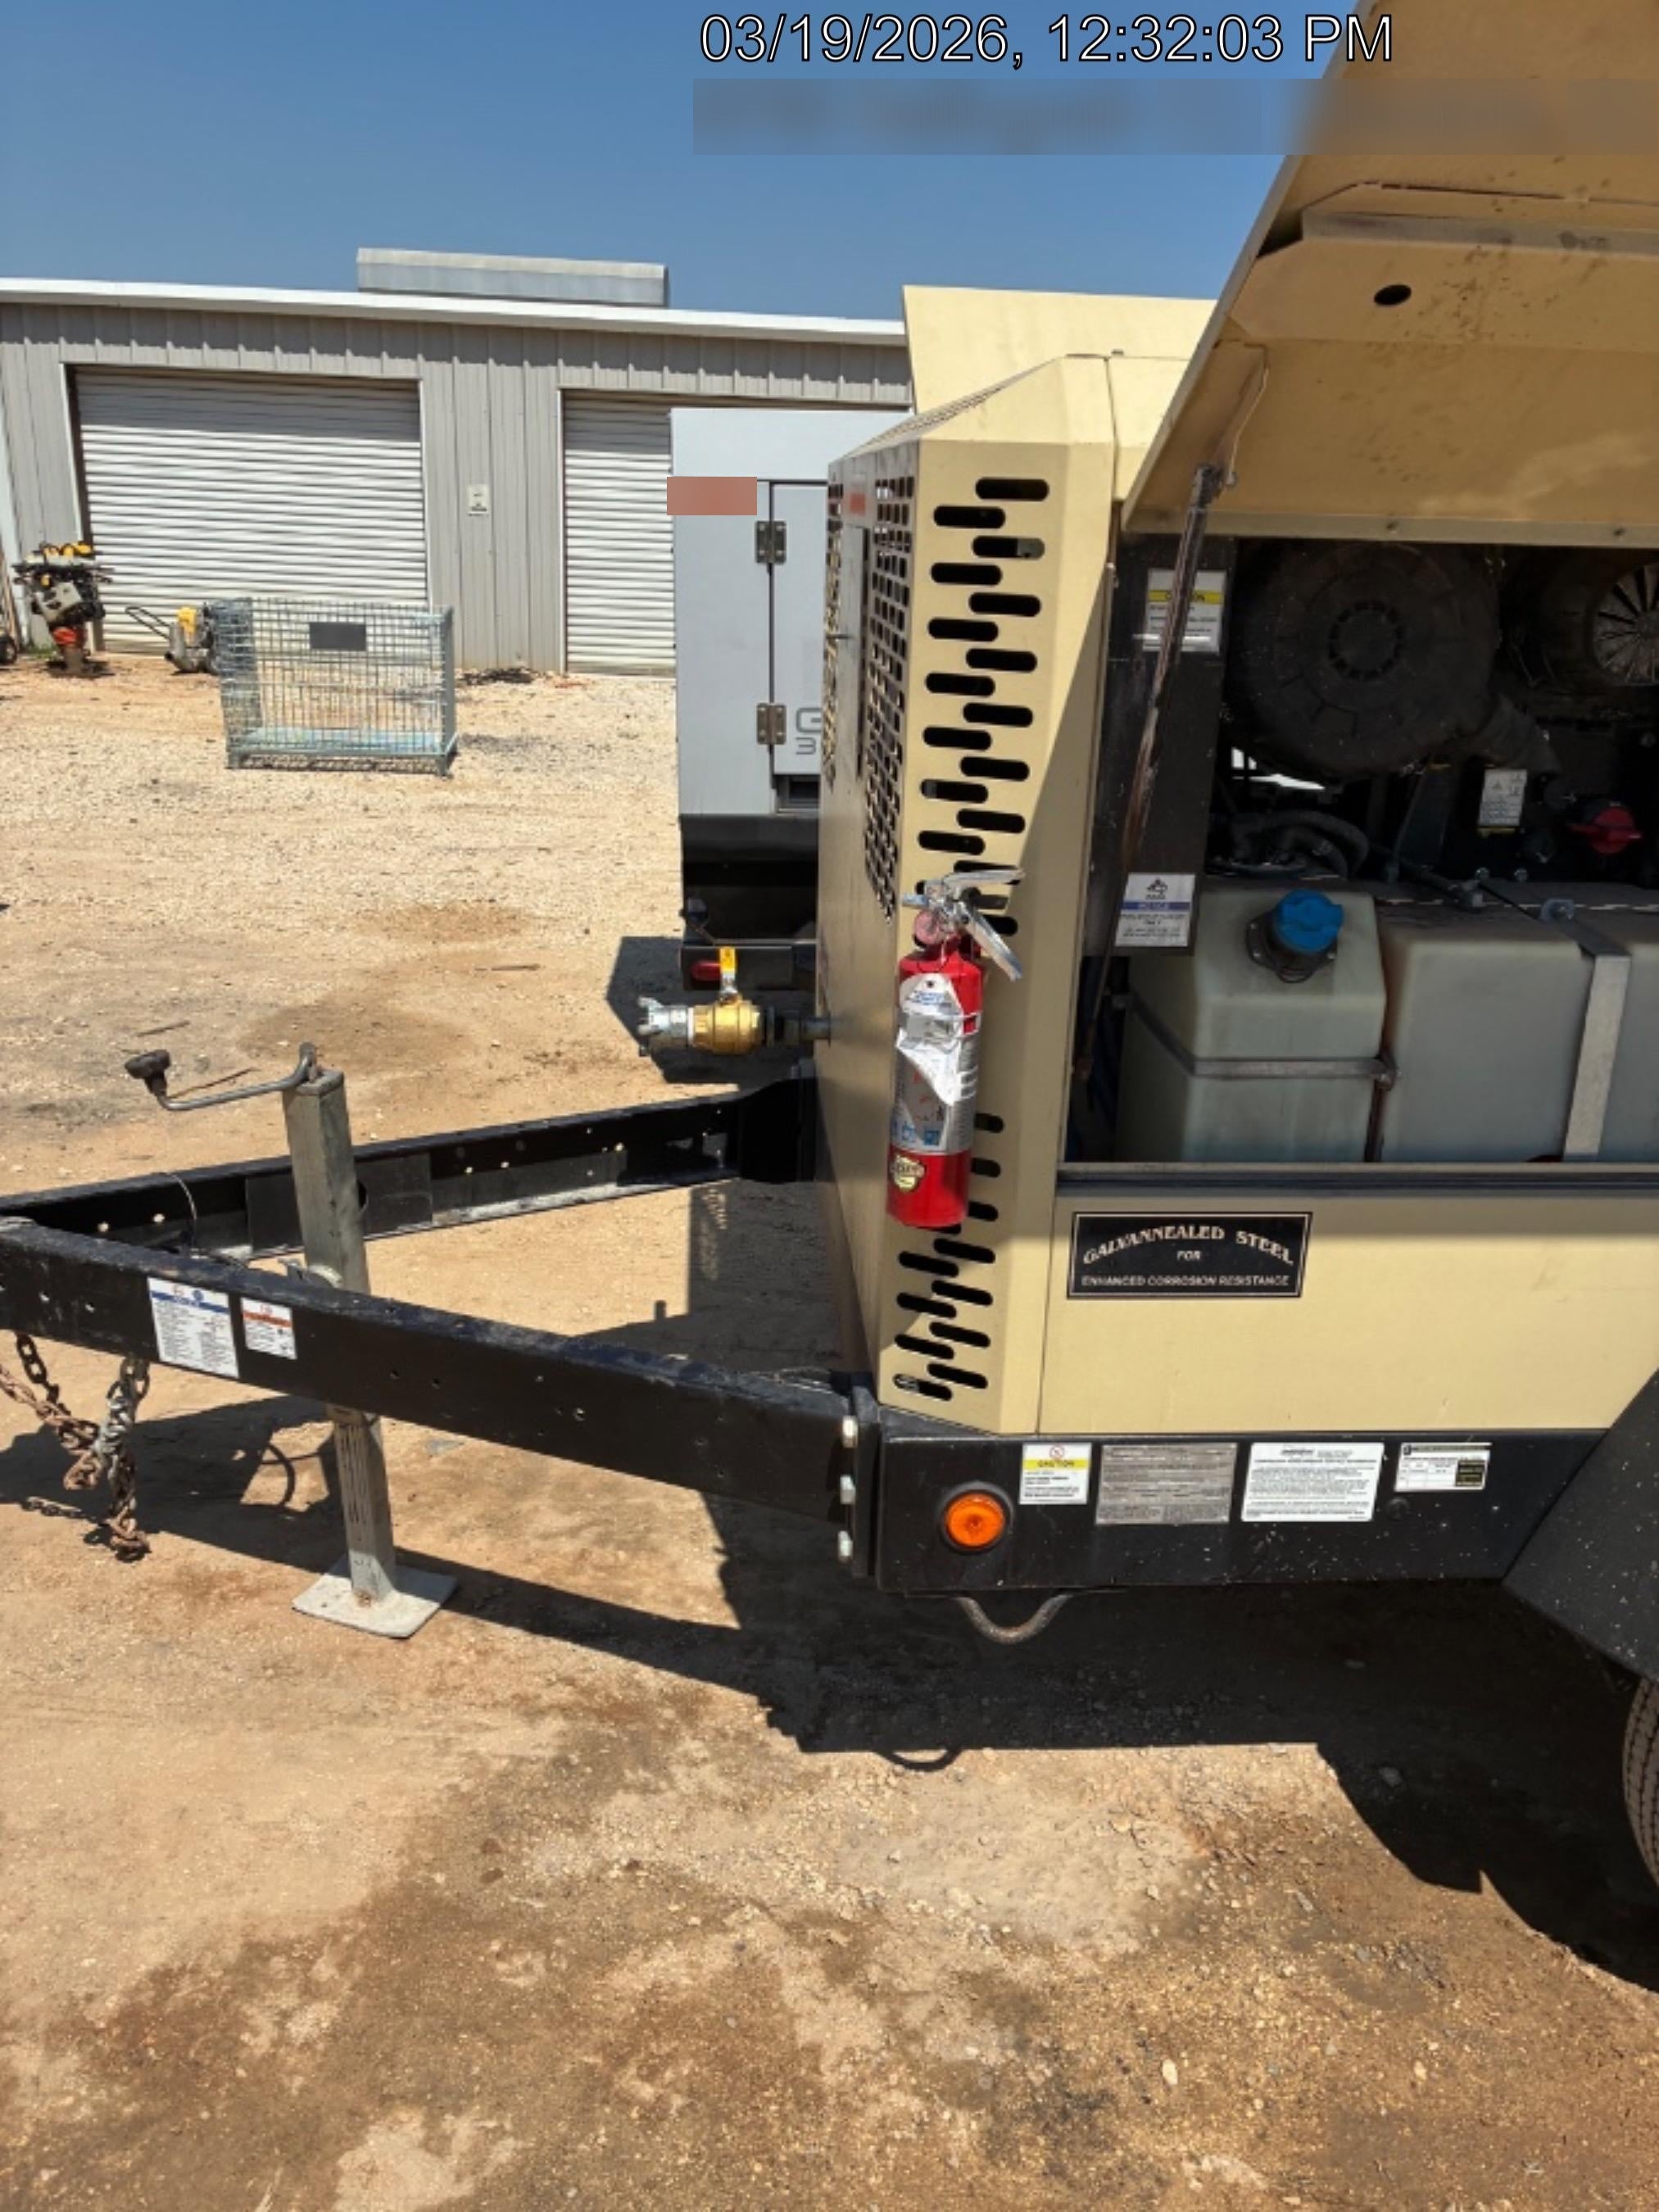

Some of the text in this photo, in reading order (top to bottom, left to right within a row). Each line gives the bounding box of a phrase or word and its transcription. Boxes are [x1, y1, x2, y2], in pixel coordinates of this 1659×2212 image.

[1082, 1224, 1294, 1265] GALVANNEALED STEEL
[1176, 1250, 1201, 1260] FOR
[1081, 1274, 1290, 1286] ENHANCED CORROSION RESISTANCE
